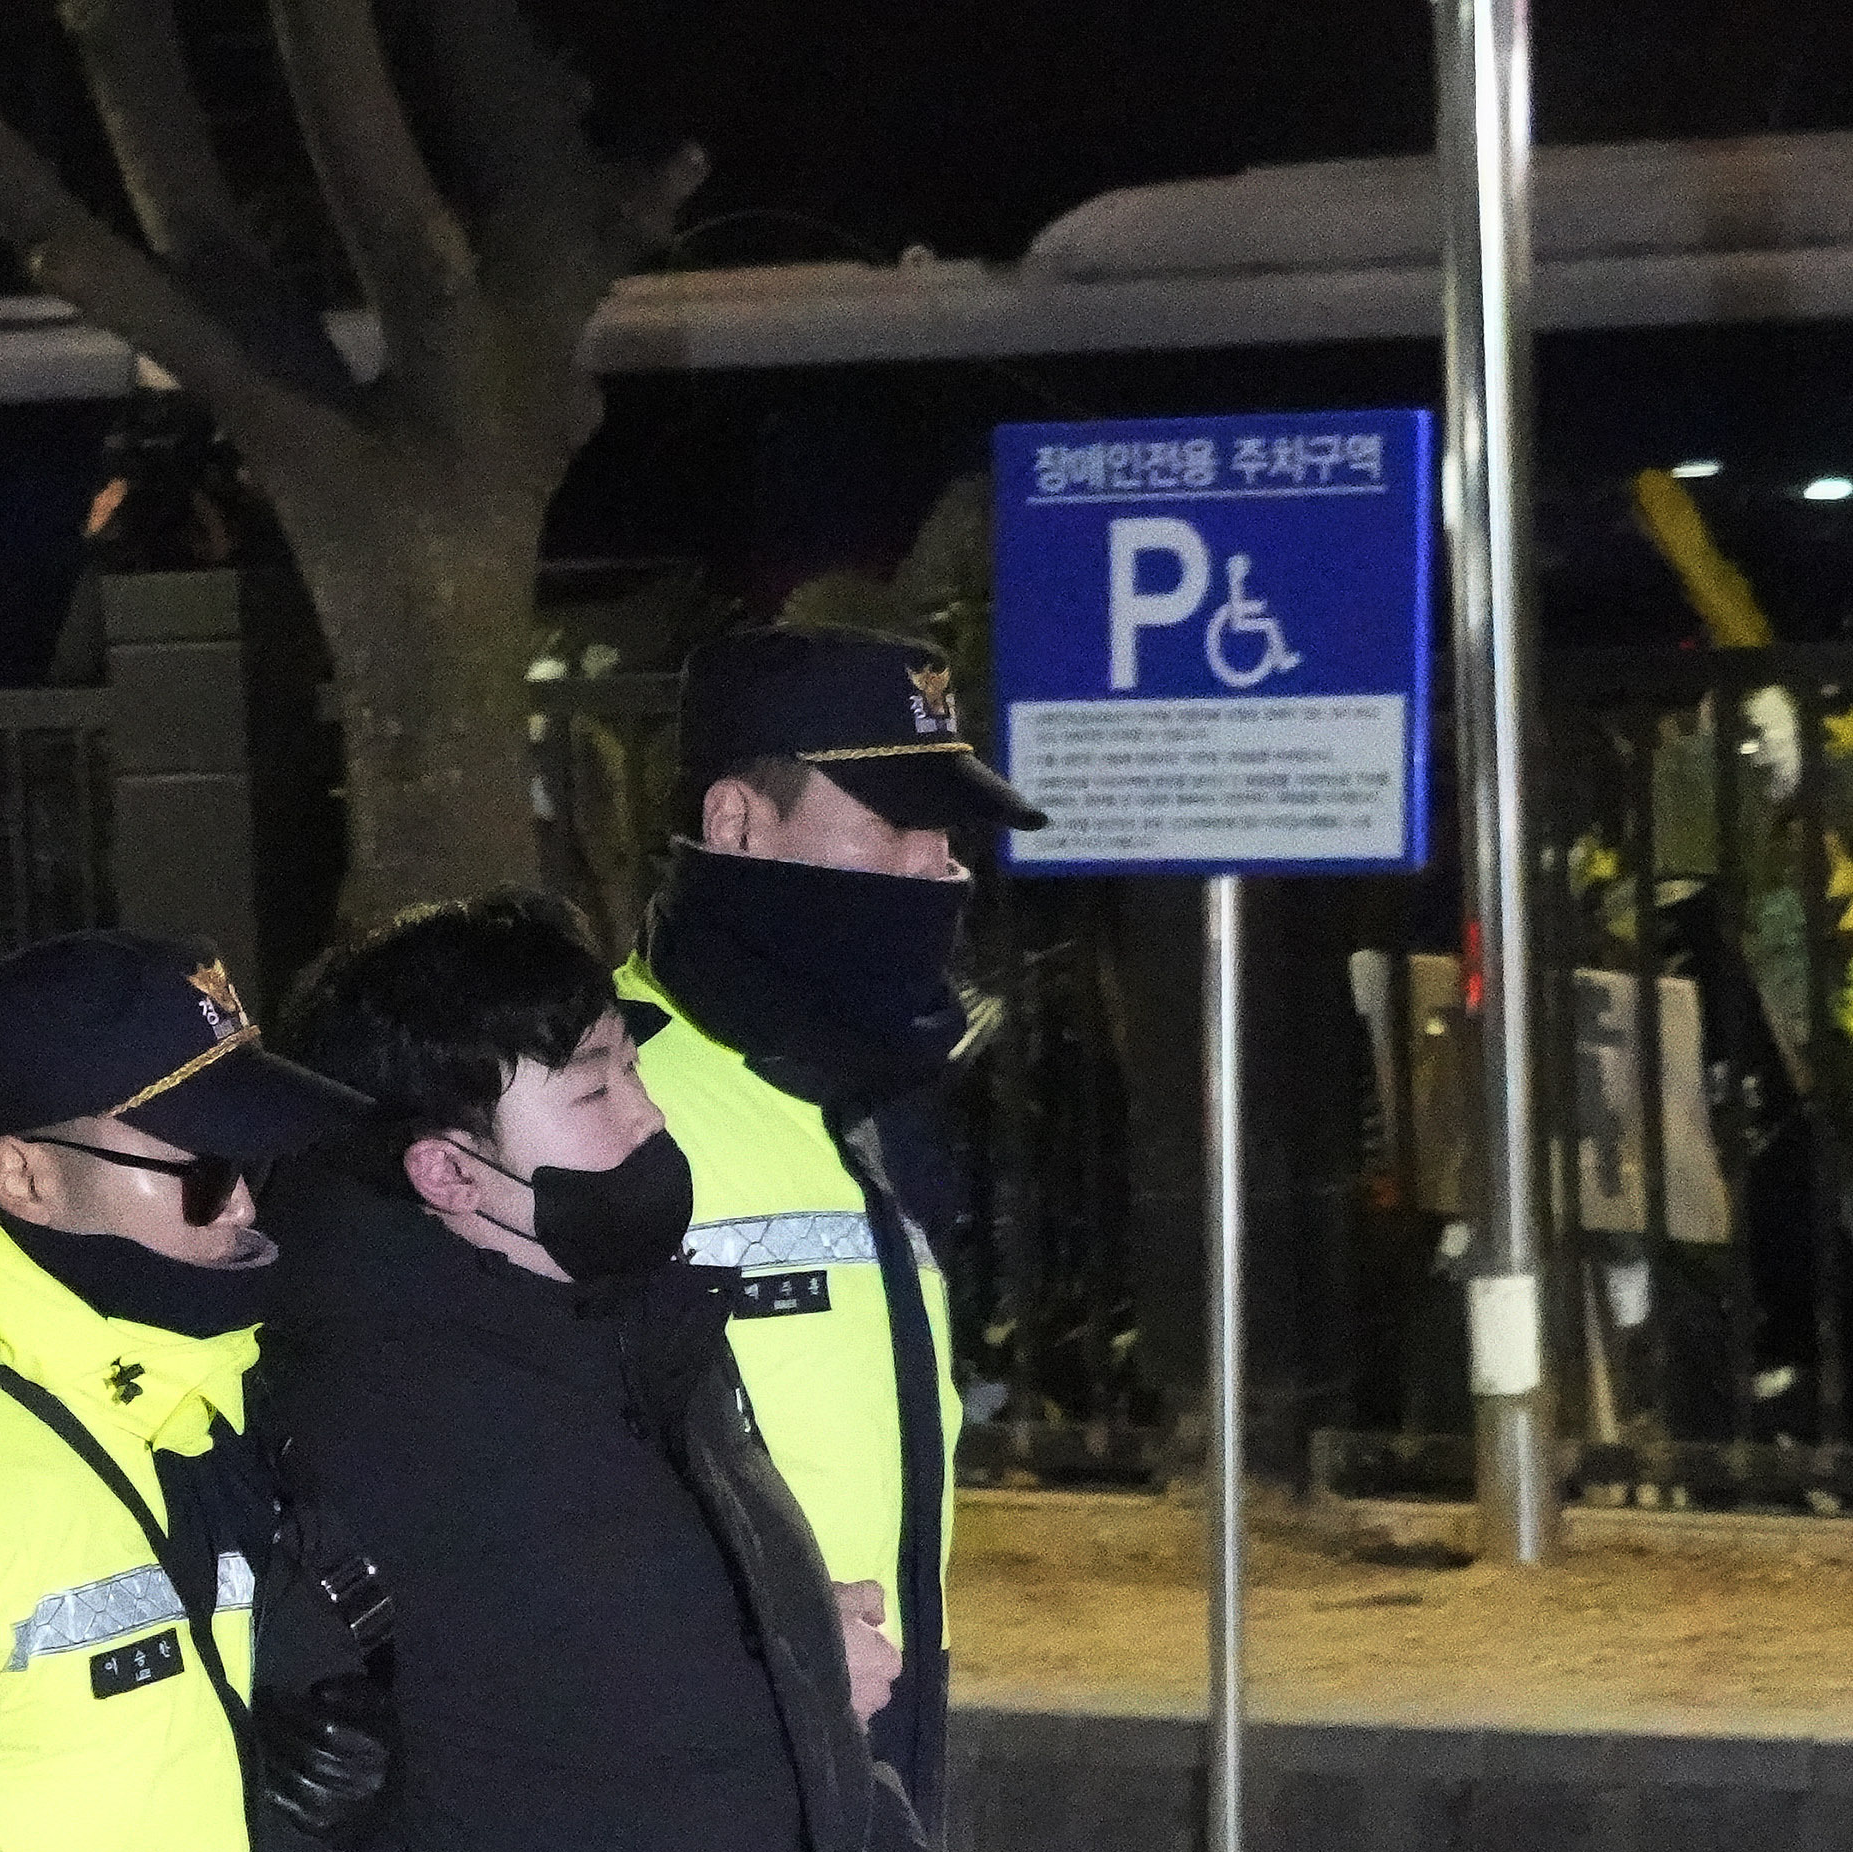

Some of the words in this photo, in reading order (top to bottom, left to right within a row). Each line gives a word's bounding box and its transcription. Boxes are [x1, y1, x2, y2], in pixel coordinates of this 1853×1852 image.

[1035, 438, 1216, 492] 장애인전용
[1231, 434, 1383, 483] 주차구역
[1109, 516, 1209, 690] P
